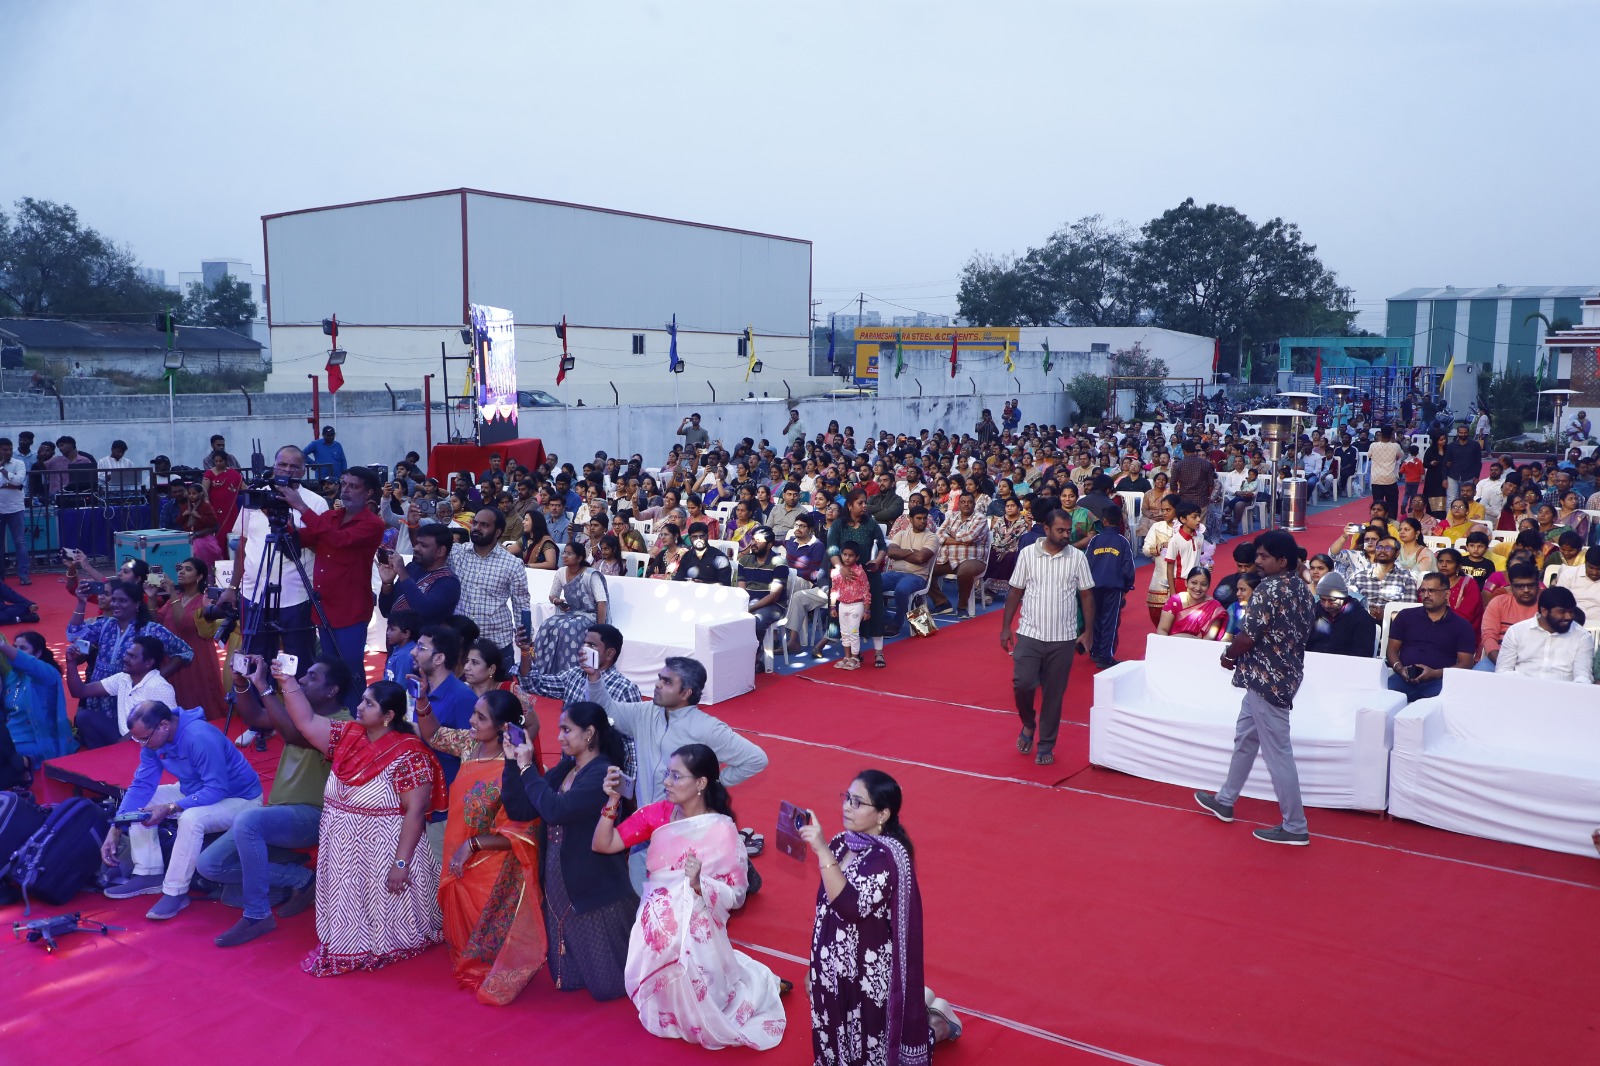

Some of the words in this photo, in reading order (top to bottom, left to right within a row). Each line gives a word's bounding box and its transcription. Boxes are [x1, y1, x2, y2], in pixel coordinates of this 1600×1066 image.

[859, 332, 910, 340] PARAMESHWRA
[912, 332, 933, 340] STEEL
[935, 332, 941, 340] &
[942, 332, 981, 340] CEENTS.
